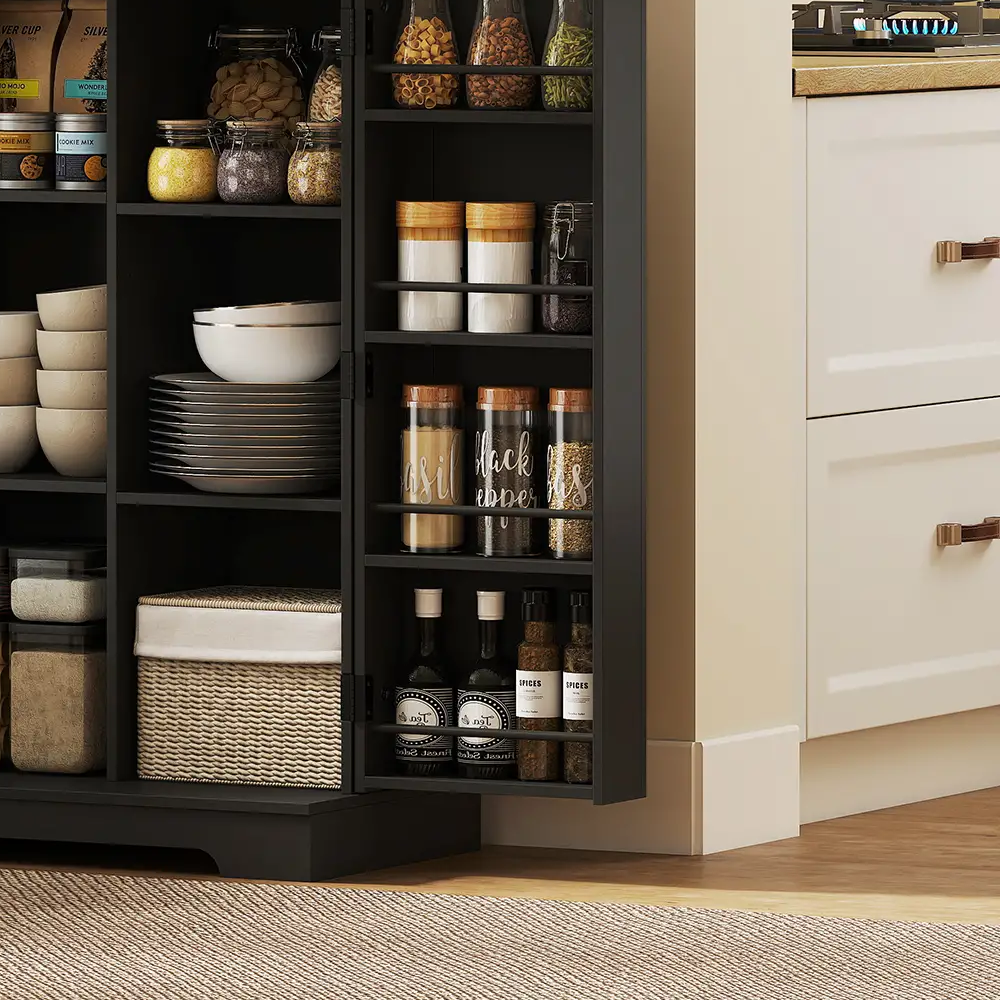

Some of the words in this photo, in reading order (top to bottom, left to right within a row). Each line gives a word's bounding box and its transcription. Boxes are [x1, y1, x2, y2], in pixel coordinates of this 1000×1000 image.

[21, 25, 42, 35] CUP
[84, 26, 107, 36] SILVE
[59, 138, 80, 146] COOKIE
[401, 433, 459, 504] asil
[519, 679, 542, 687] SPICES
[566, 681, 589, 690] SPICES
